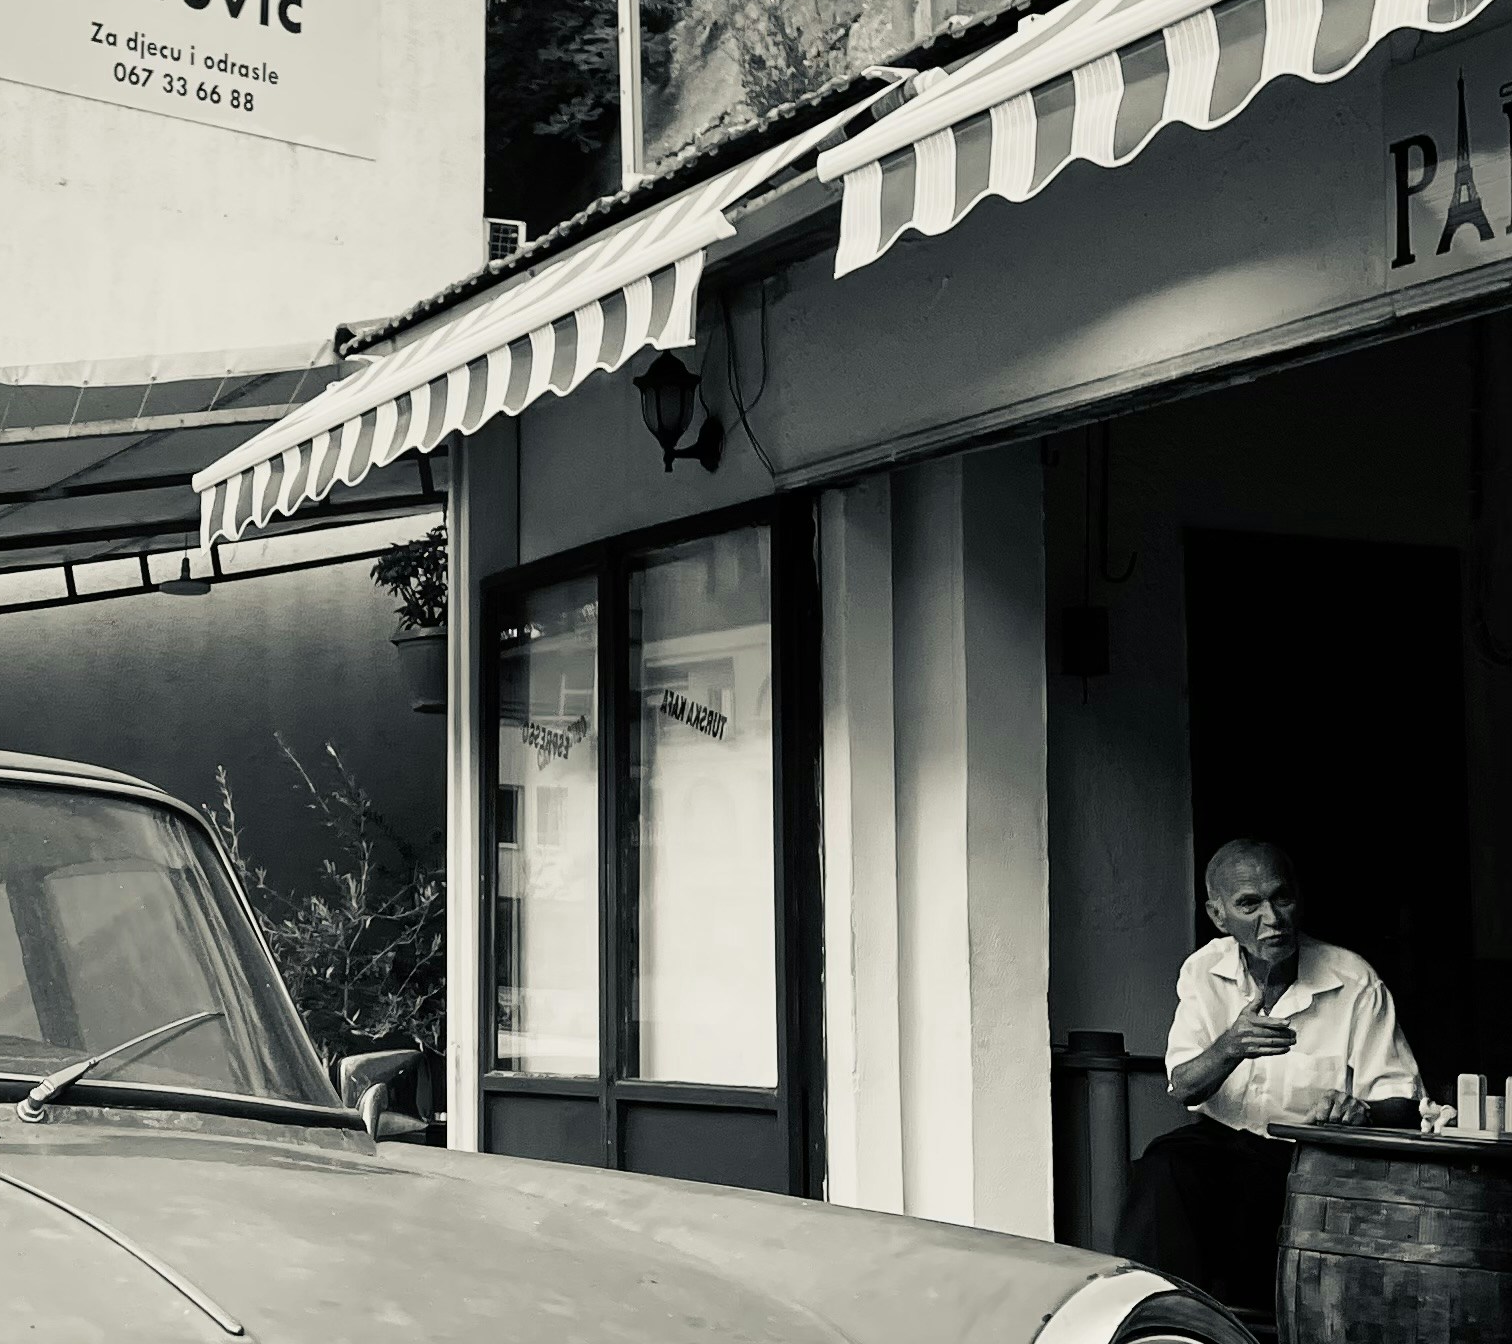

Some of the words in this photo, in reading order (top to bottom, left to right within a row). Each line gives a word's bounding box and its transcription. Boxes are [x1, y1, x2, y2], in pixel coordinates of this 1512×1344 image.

[90, 22, 119, 47] Za
[126, 32, 182, 64] djecu
[189, 45, 197, 67] i
[203, 53, 280, 85] odrasle
[113, 61, 153, 88] 067
[162, 73, 189, 97] 33
[196, 82, 222, 106] 66
[230, 91, 256, 113] 88
[1389, 62, 1512, 270] PA
